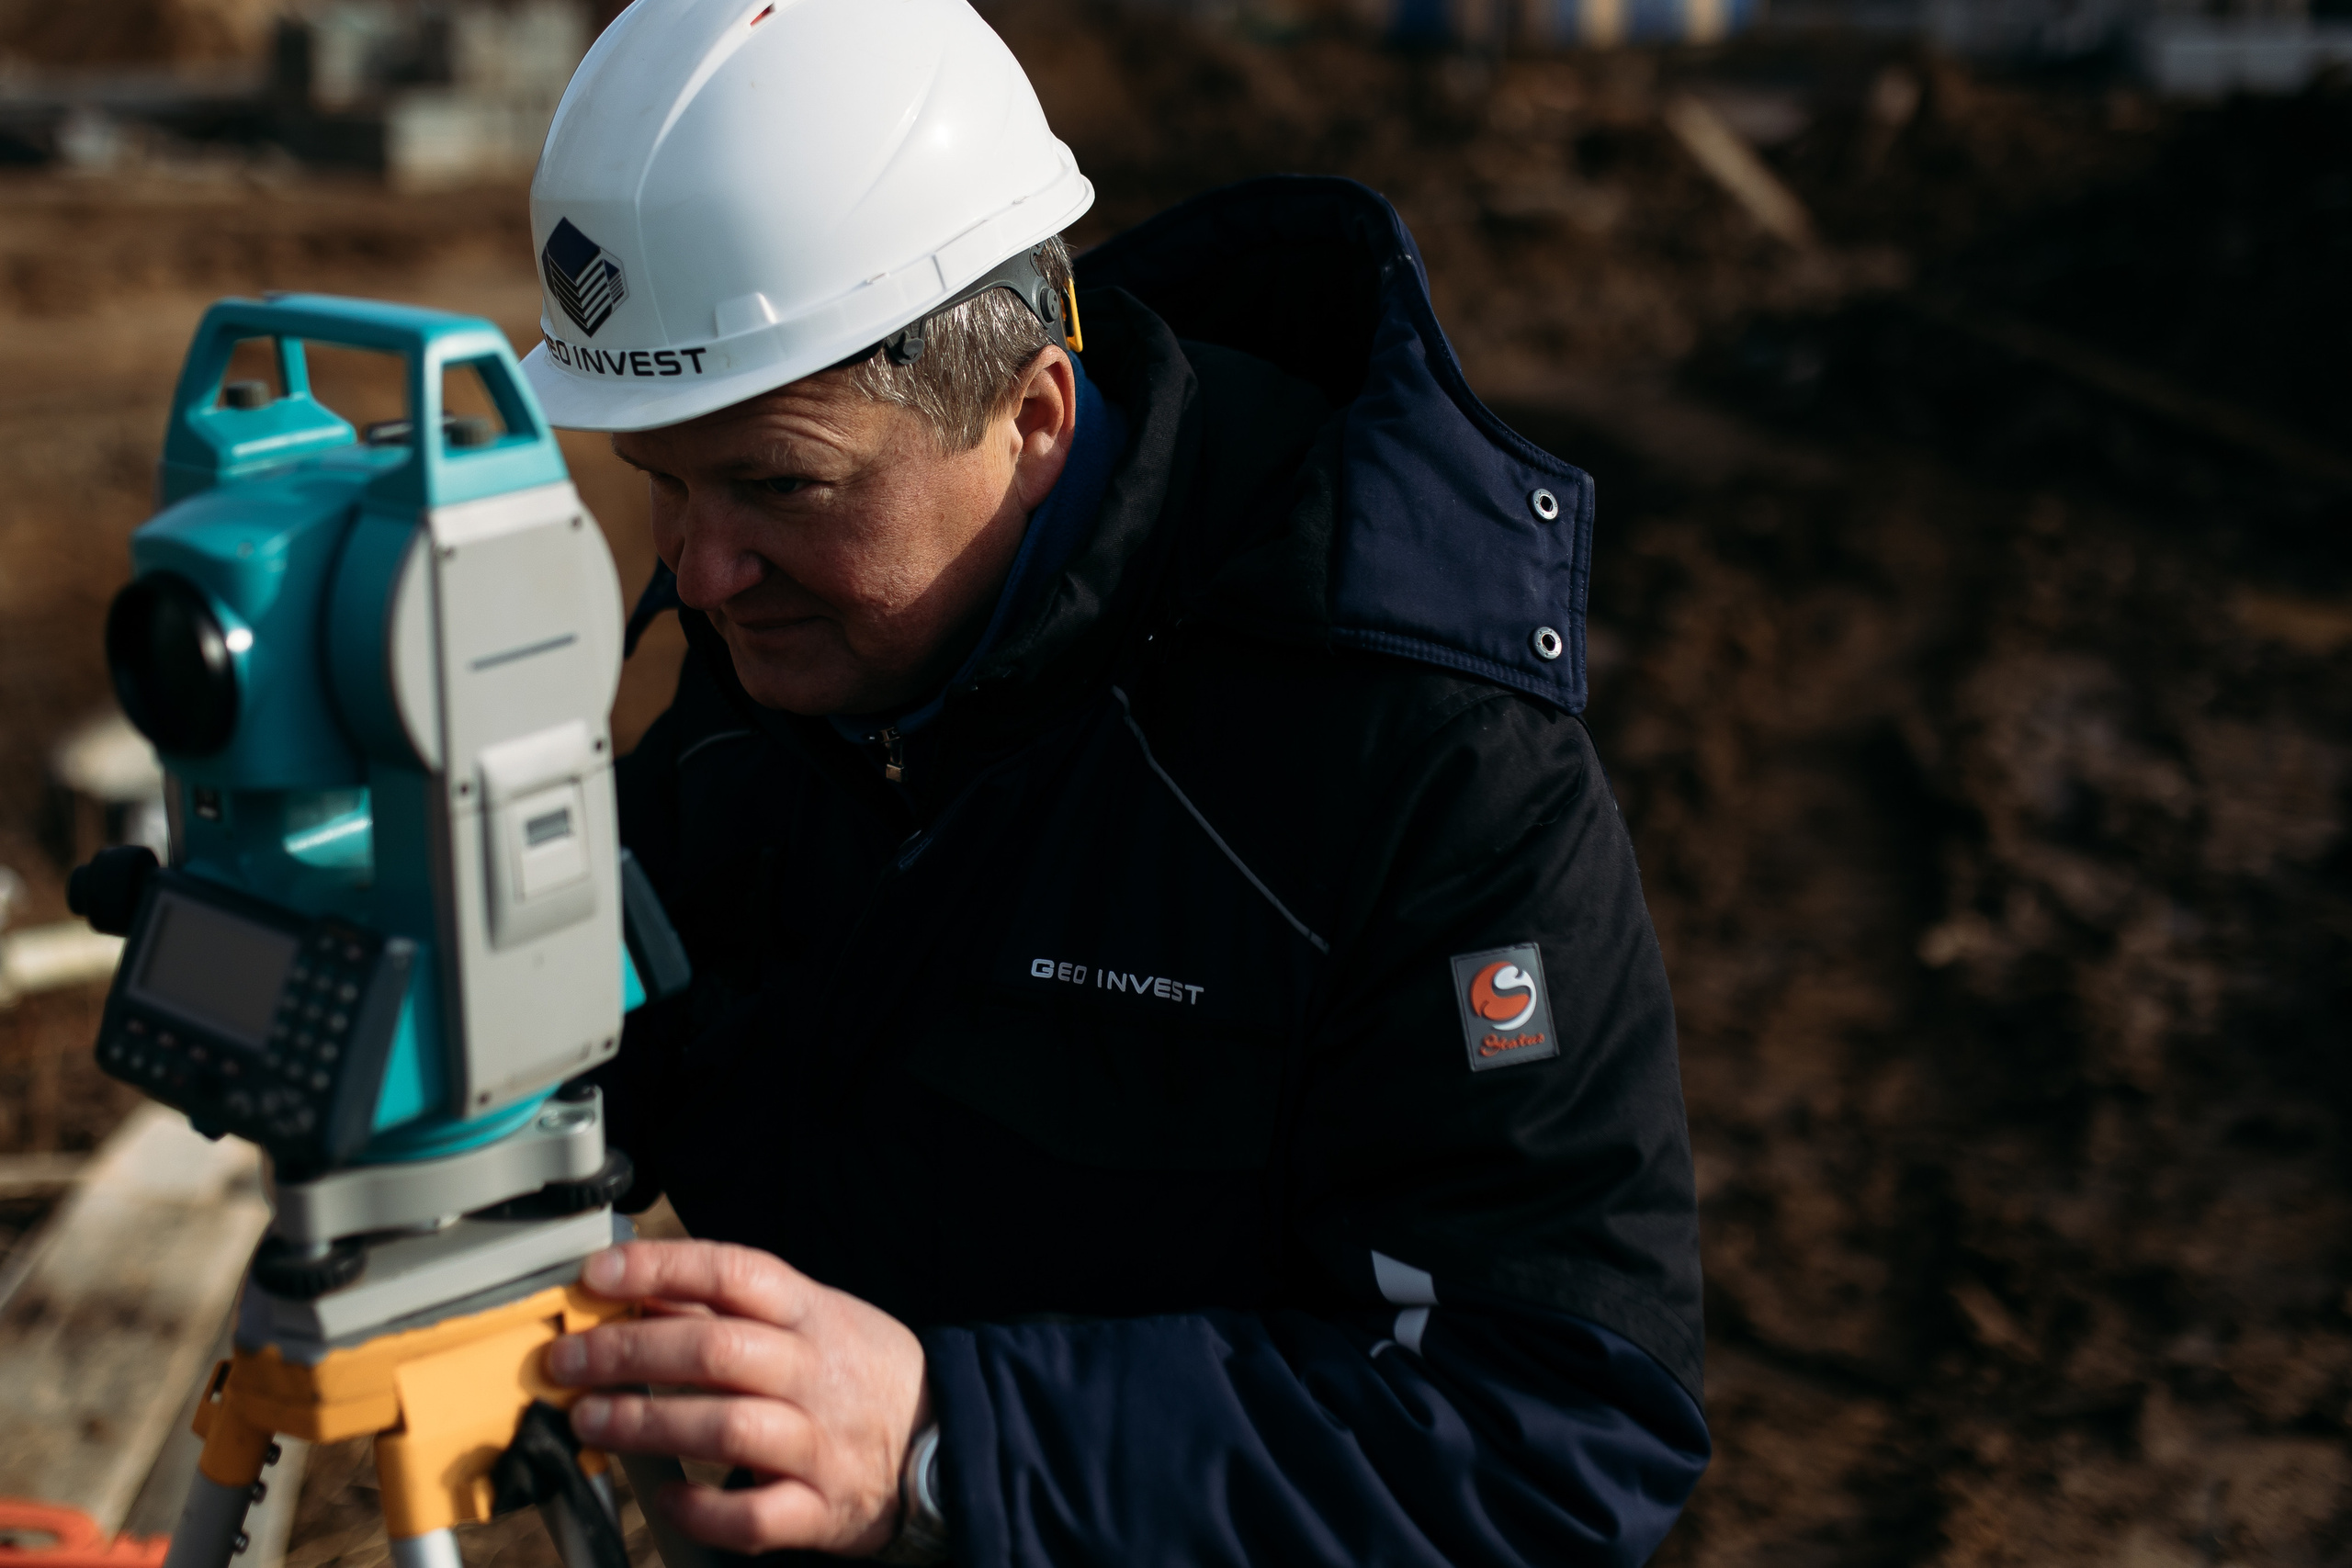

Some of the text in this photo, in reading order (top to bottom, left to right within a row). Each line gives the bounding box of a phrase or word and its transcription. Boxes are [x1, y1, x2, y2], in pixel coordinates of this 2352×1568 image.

[541, 329, 707, 377] EO INVEST
[1031, 958, 1204, 1005] GEO INVEST
